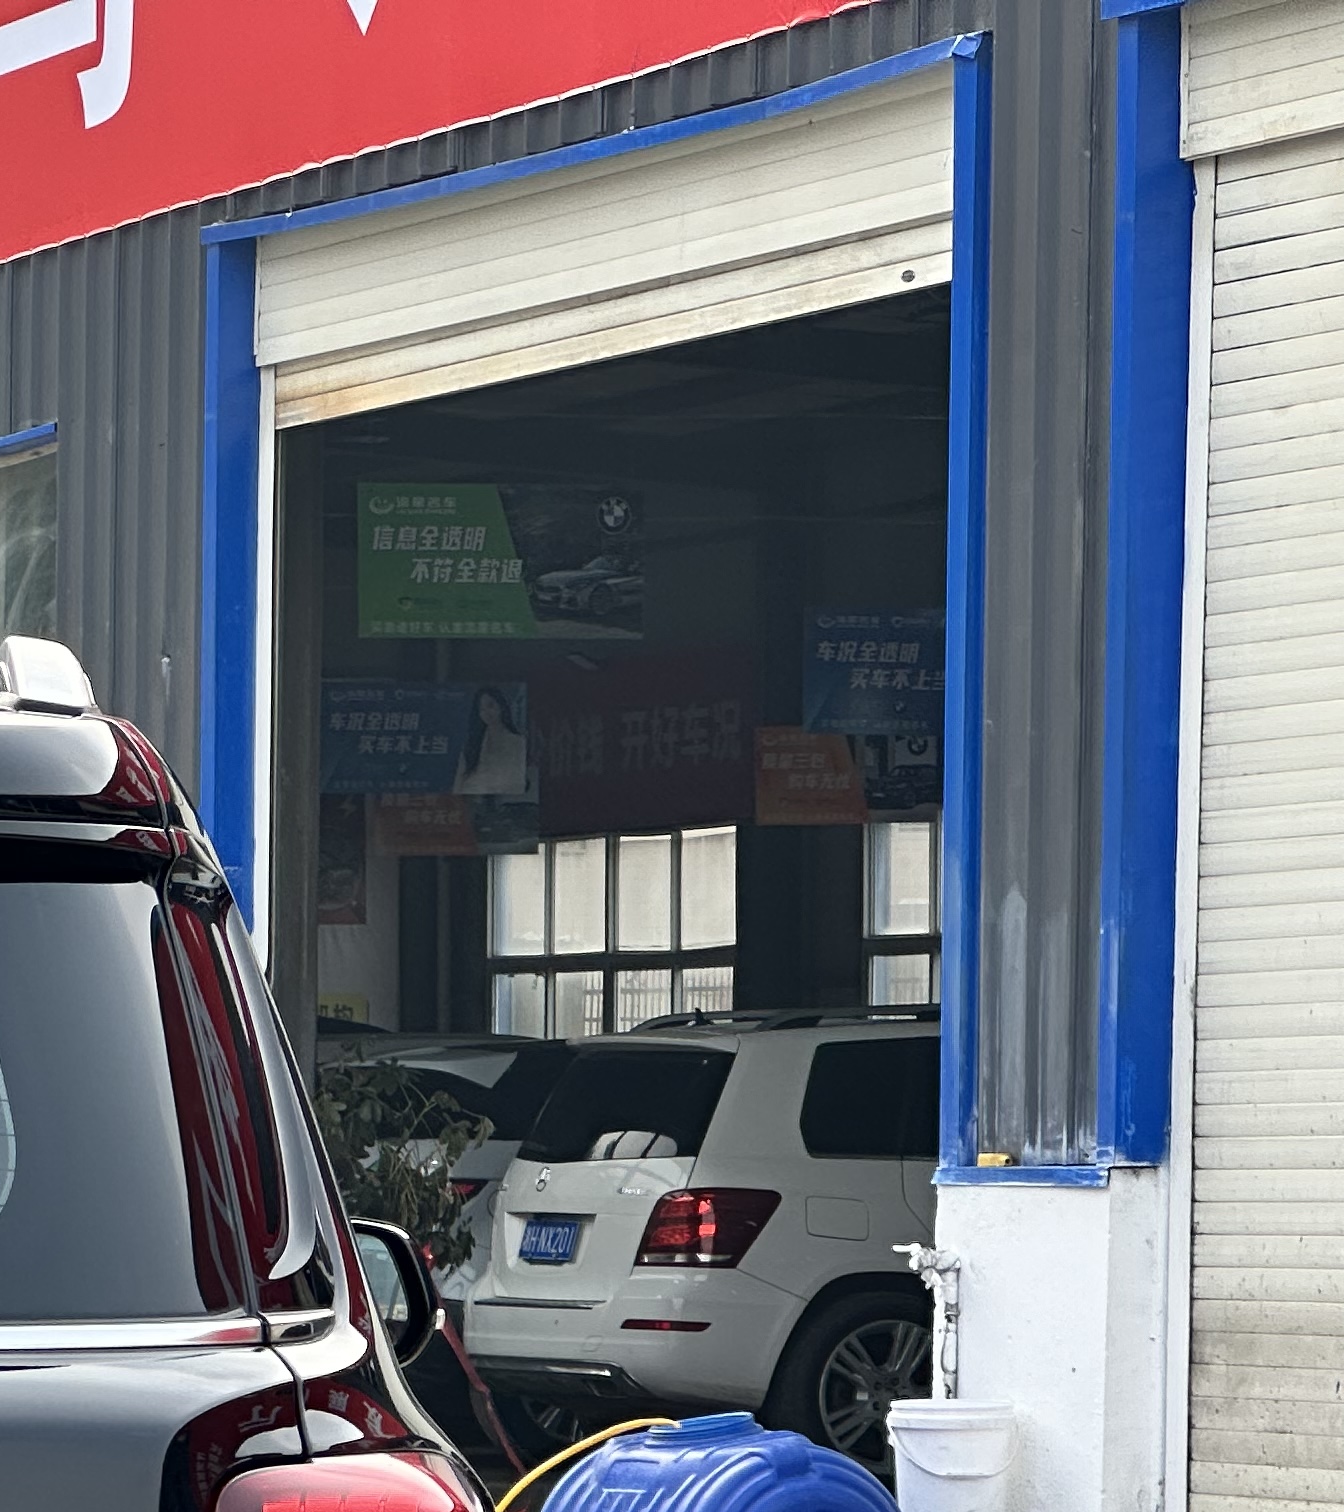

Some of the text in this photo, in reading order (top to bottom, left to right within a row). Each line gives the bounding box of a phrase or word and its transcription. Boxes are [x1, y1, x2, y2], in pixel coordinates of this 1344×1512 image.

[372, 525, 486, 551] 信息全透明
[410, 558, 523, 583] 不符全款退
[816, 640, 920, 663] 车况全透明
[359, 736, 448, 754] 买车不上当
